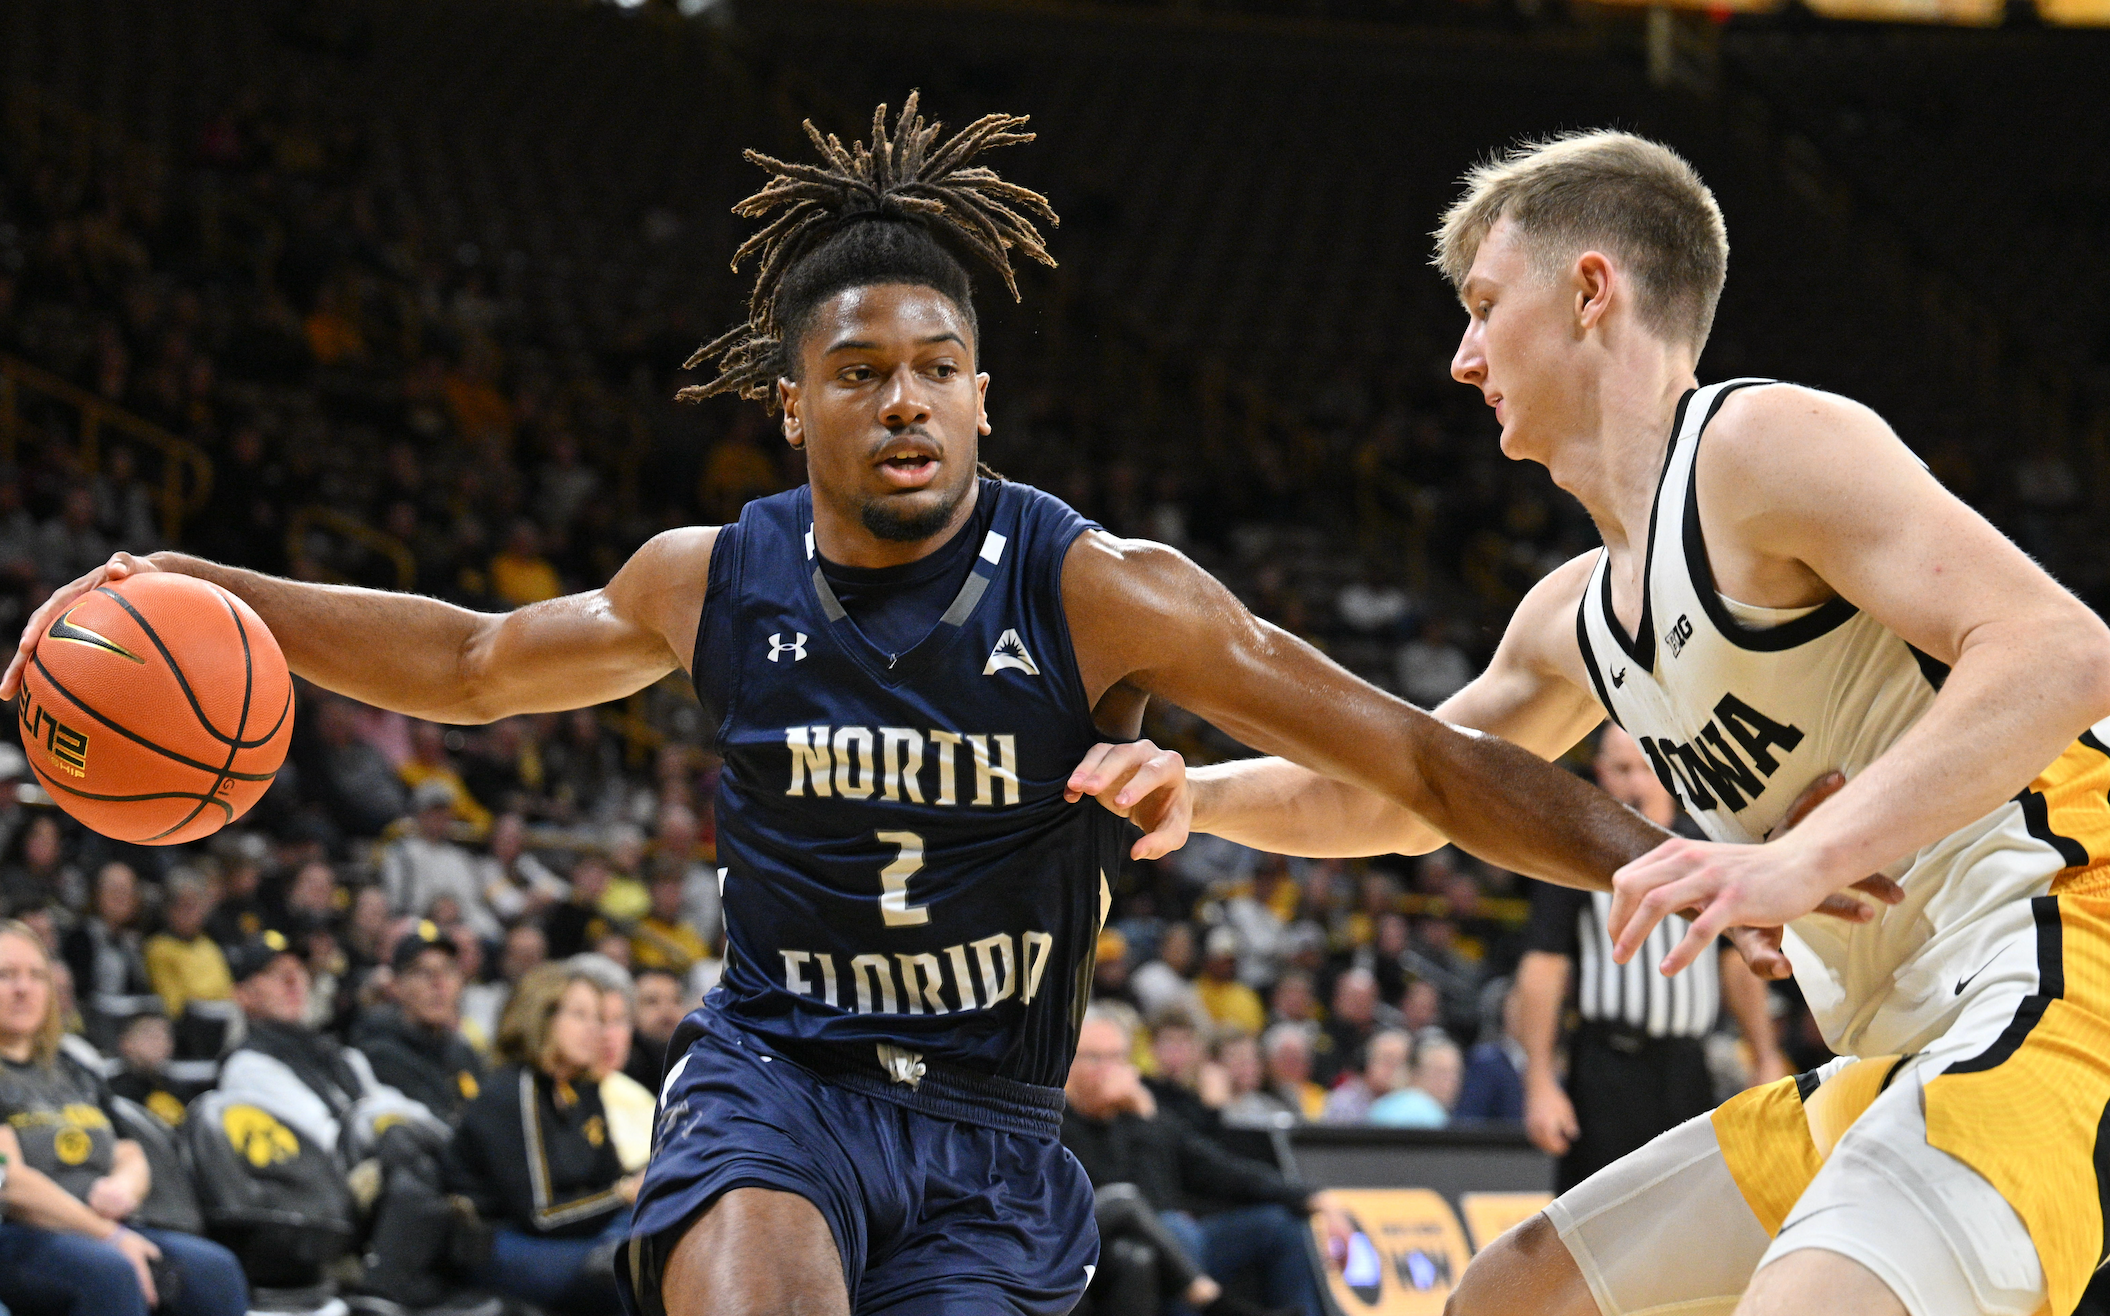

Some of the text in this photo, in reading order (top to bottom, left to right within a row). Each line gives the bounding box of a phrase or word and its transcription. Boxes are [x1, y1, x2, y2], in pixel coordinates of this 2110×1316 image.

[785, 725, 1021, 806] NORTH
[1640, 692, 1805, 813] IOWA
[875, 830, 930, 928] 2
